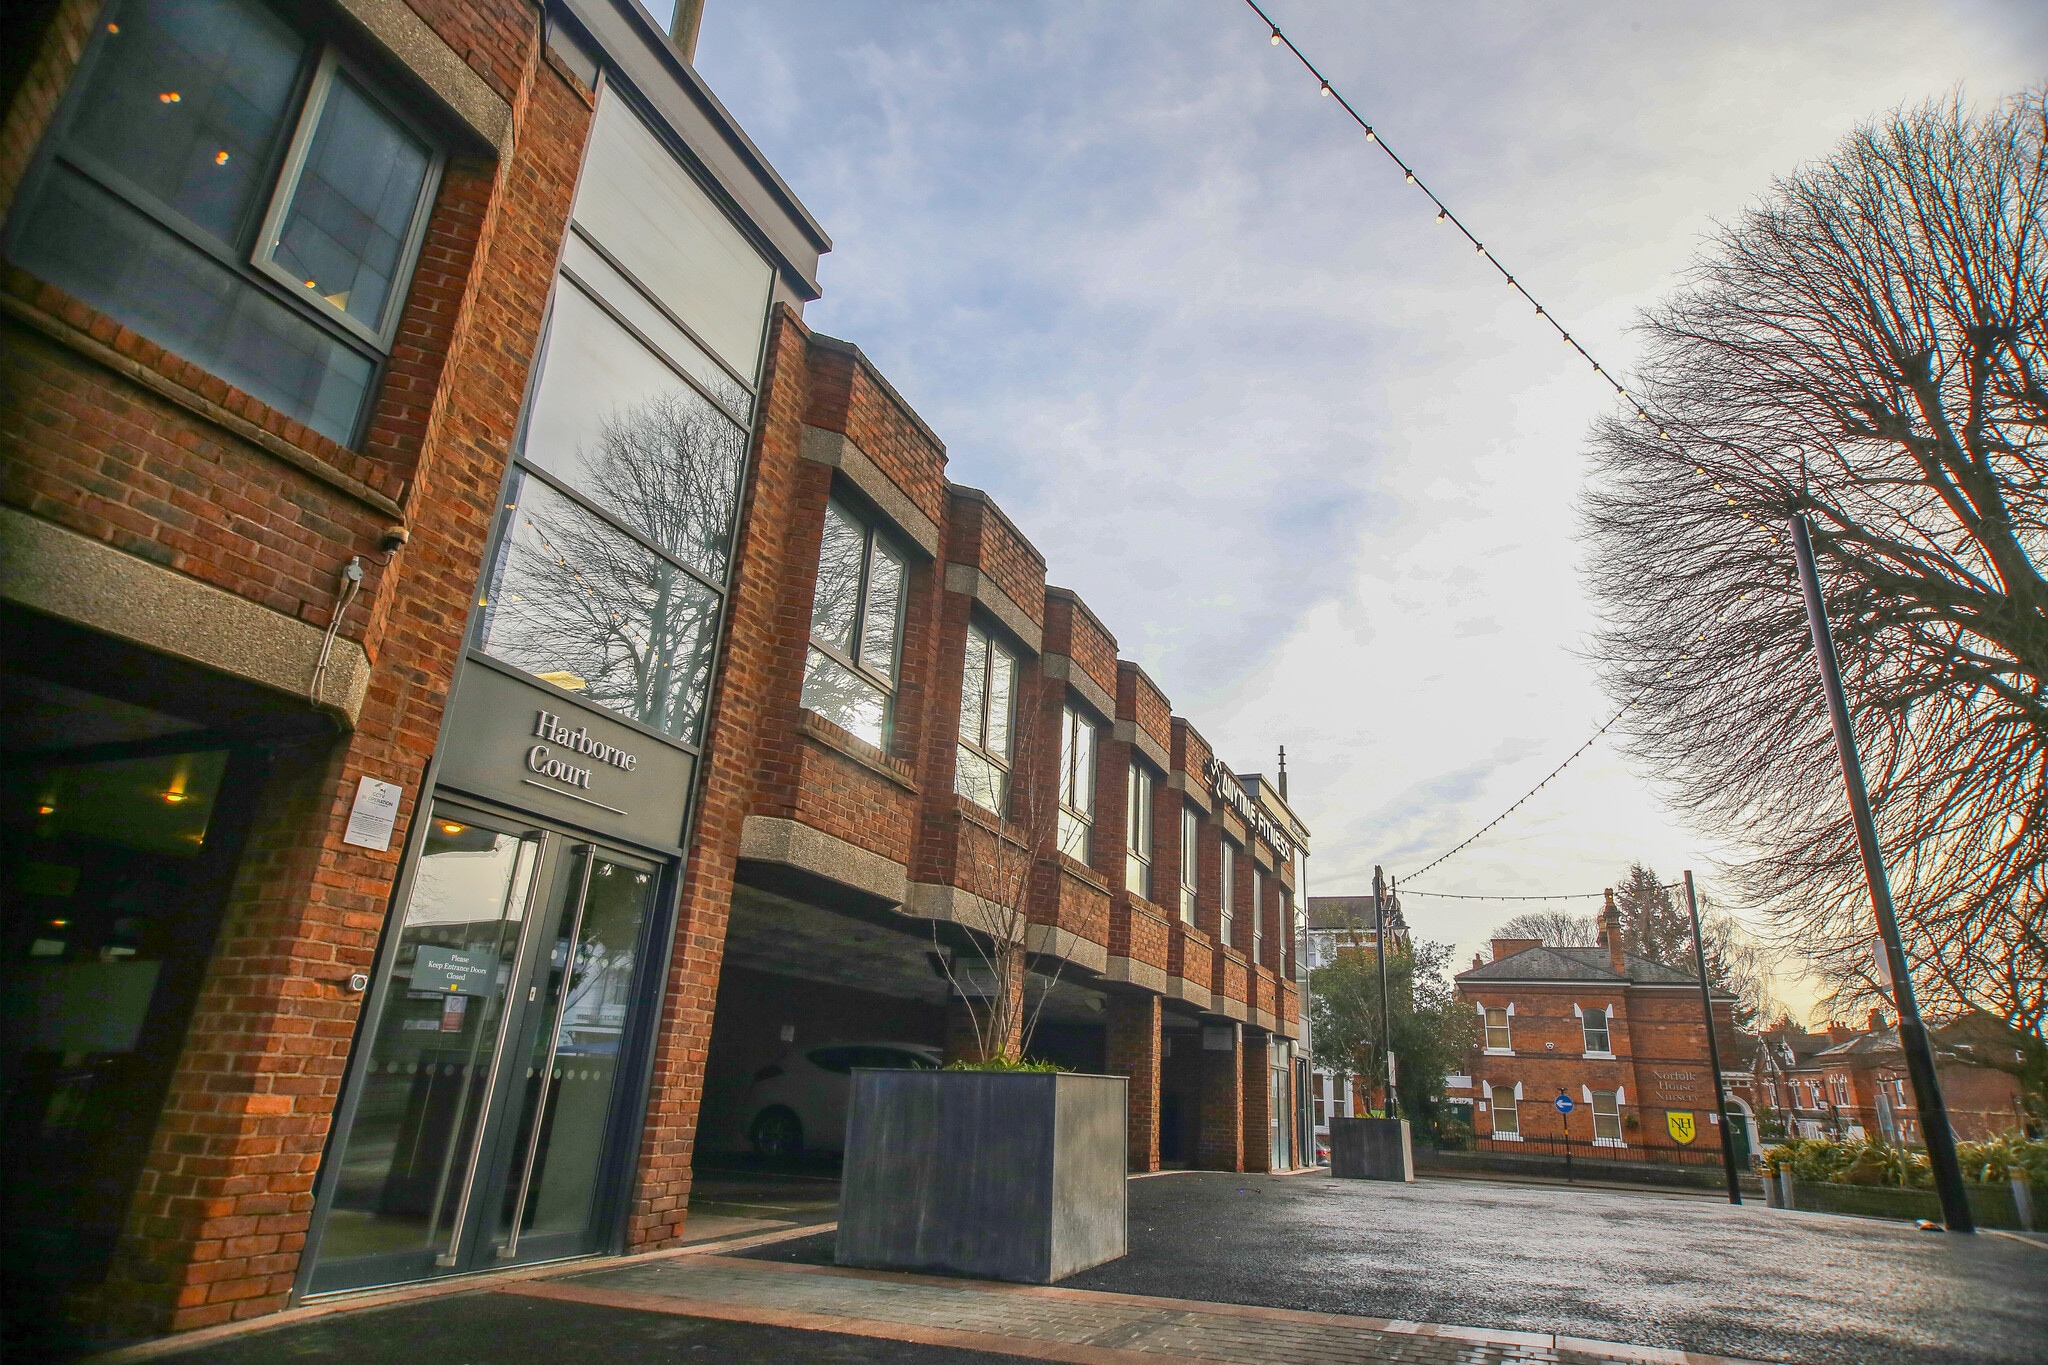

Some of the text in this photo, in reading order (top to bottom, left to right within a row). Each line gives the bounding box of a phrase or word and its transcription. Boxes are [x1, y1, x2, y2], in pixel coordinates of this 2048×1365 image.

[534, 709, 637, 772] Harborne
[528, 745, 592, 790] Court
[372, 791, 386, 799] CCTV
[367, 796, 393, 807] OPERATION
[1258, 811, 1290, 862] FITNESS
[451, 954, 469, 963] Please
[428, 960, 487, 975] Keep Entrance Doors
[446, 972, 466, 981] Closed
[1654, 1071, 1696, 1081] Norfolk
[1658, 1081, 1695, 1092] House
[1655, 1091, 1699, 1102] Nursery
